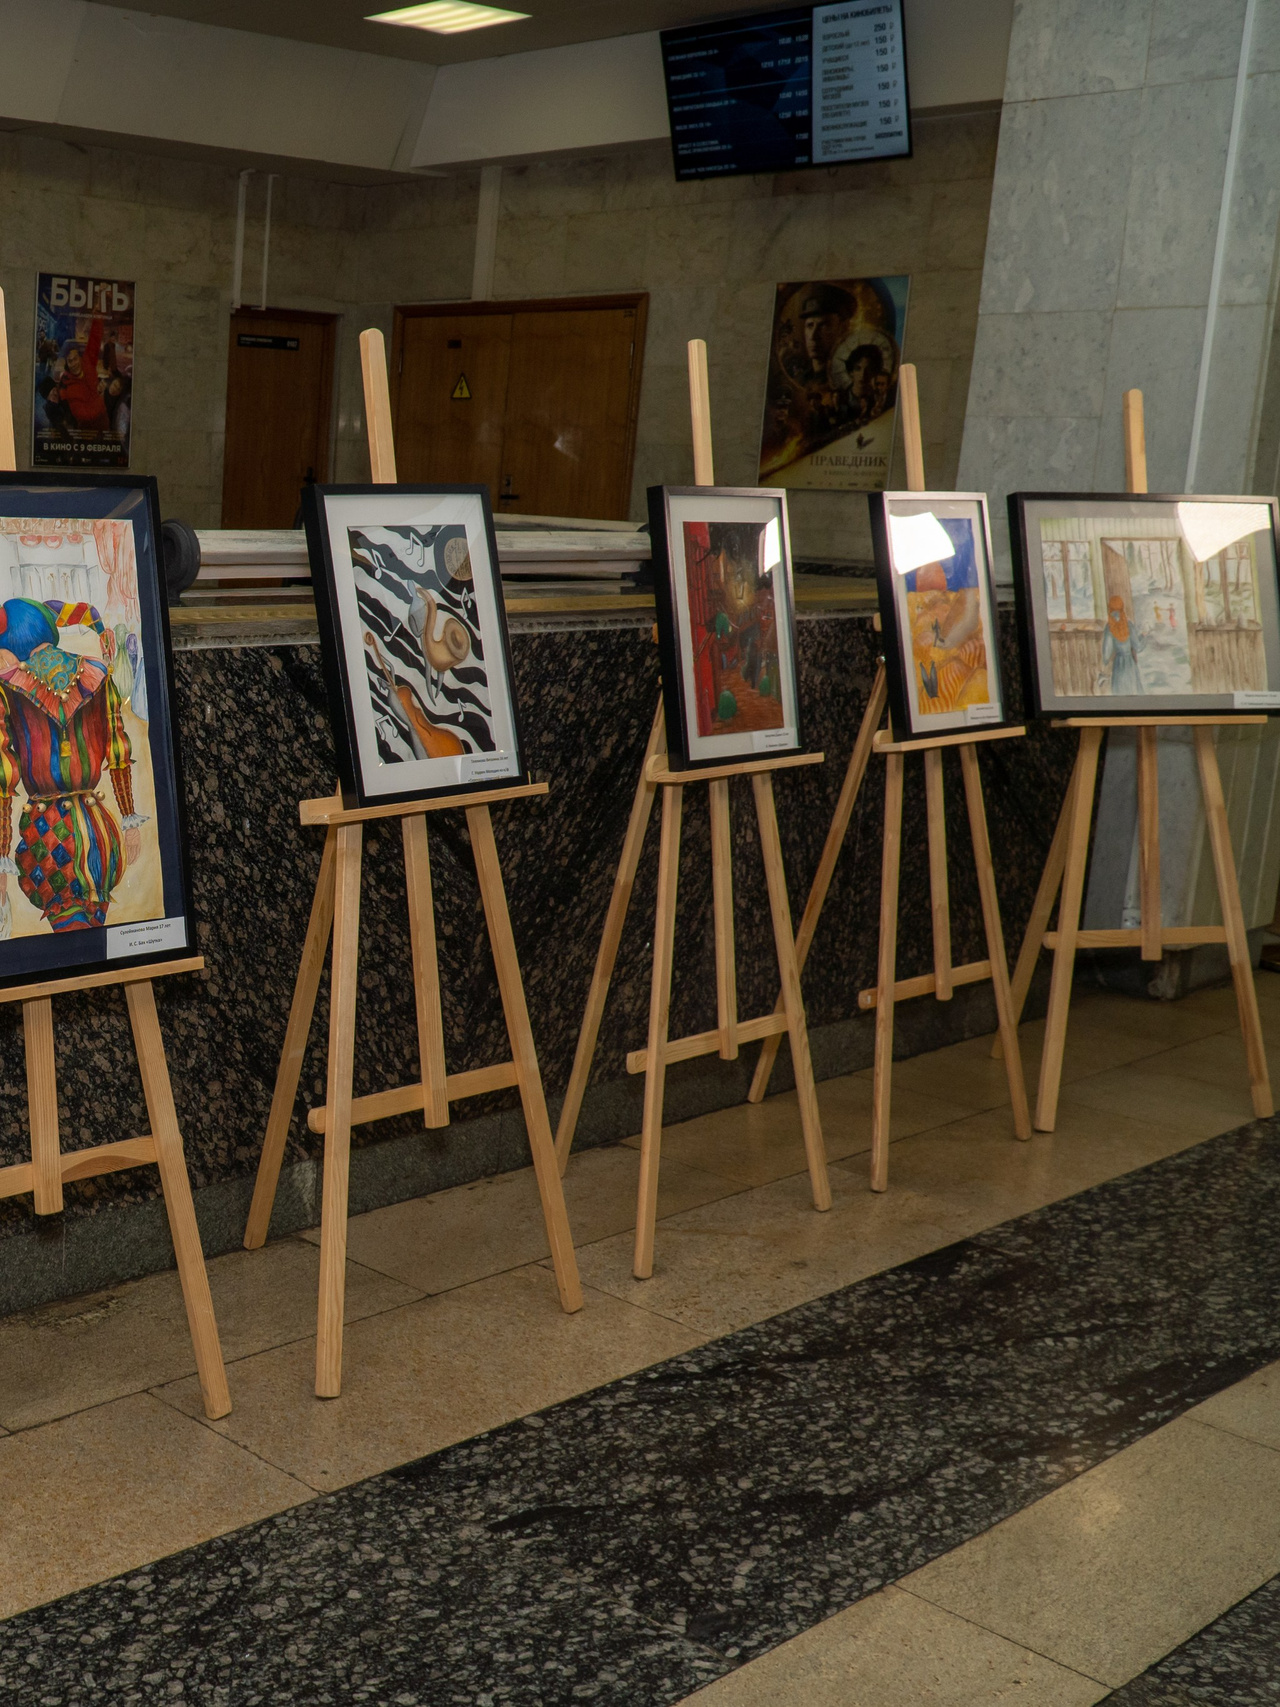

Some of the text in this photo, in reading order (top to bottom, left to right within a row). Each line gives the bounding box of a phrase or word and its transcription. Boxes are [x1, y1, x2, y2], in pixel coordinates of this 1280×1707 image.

[822, 13, 840, 23] ЦЕНЫ
[850, 5, 893, 18] КИНОБИЛЕТЫ
[874, 22, 886, 32] 250
[875, 35, 887, 44] 150
[875, 47, 888, 56] 150
[876, 63, 889, 72] 150
[878, 81, 890, 90] 150
[878, 99, 891, 108] 150
[879, 116, 892, 125] 150
[50, 277, 129, 313] БЫТЬ
[43, 442, 122, 453] В КИНО С 9 ФЕВРАЛЯ
[809, 455, 888, 469] ПРАВЕДНИК
